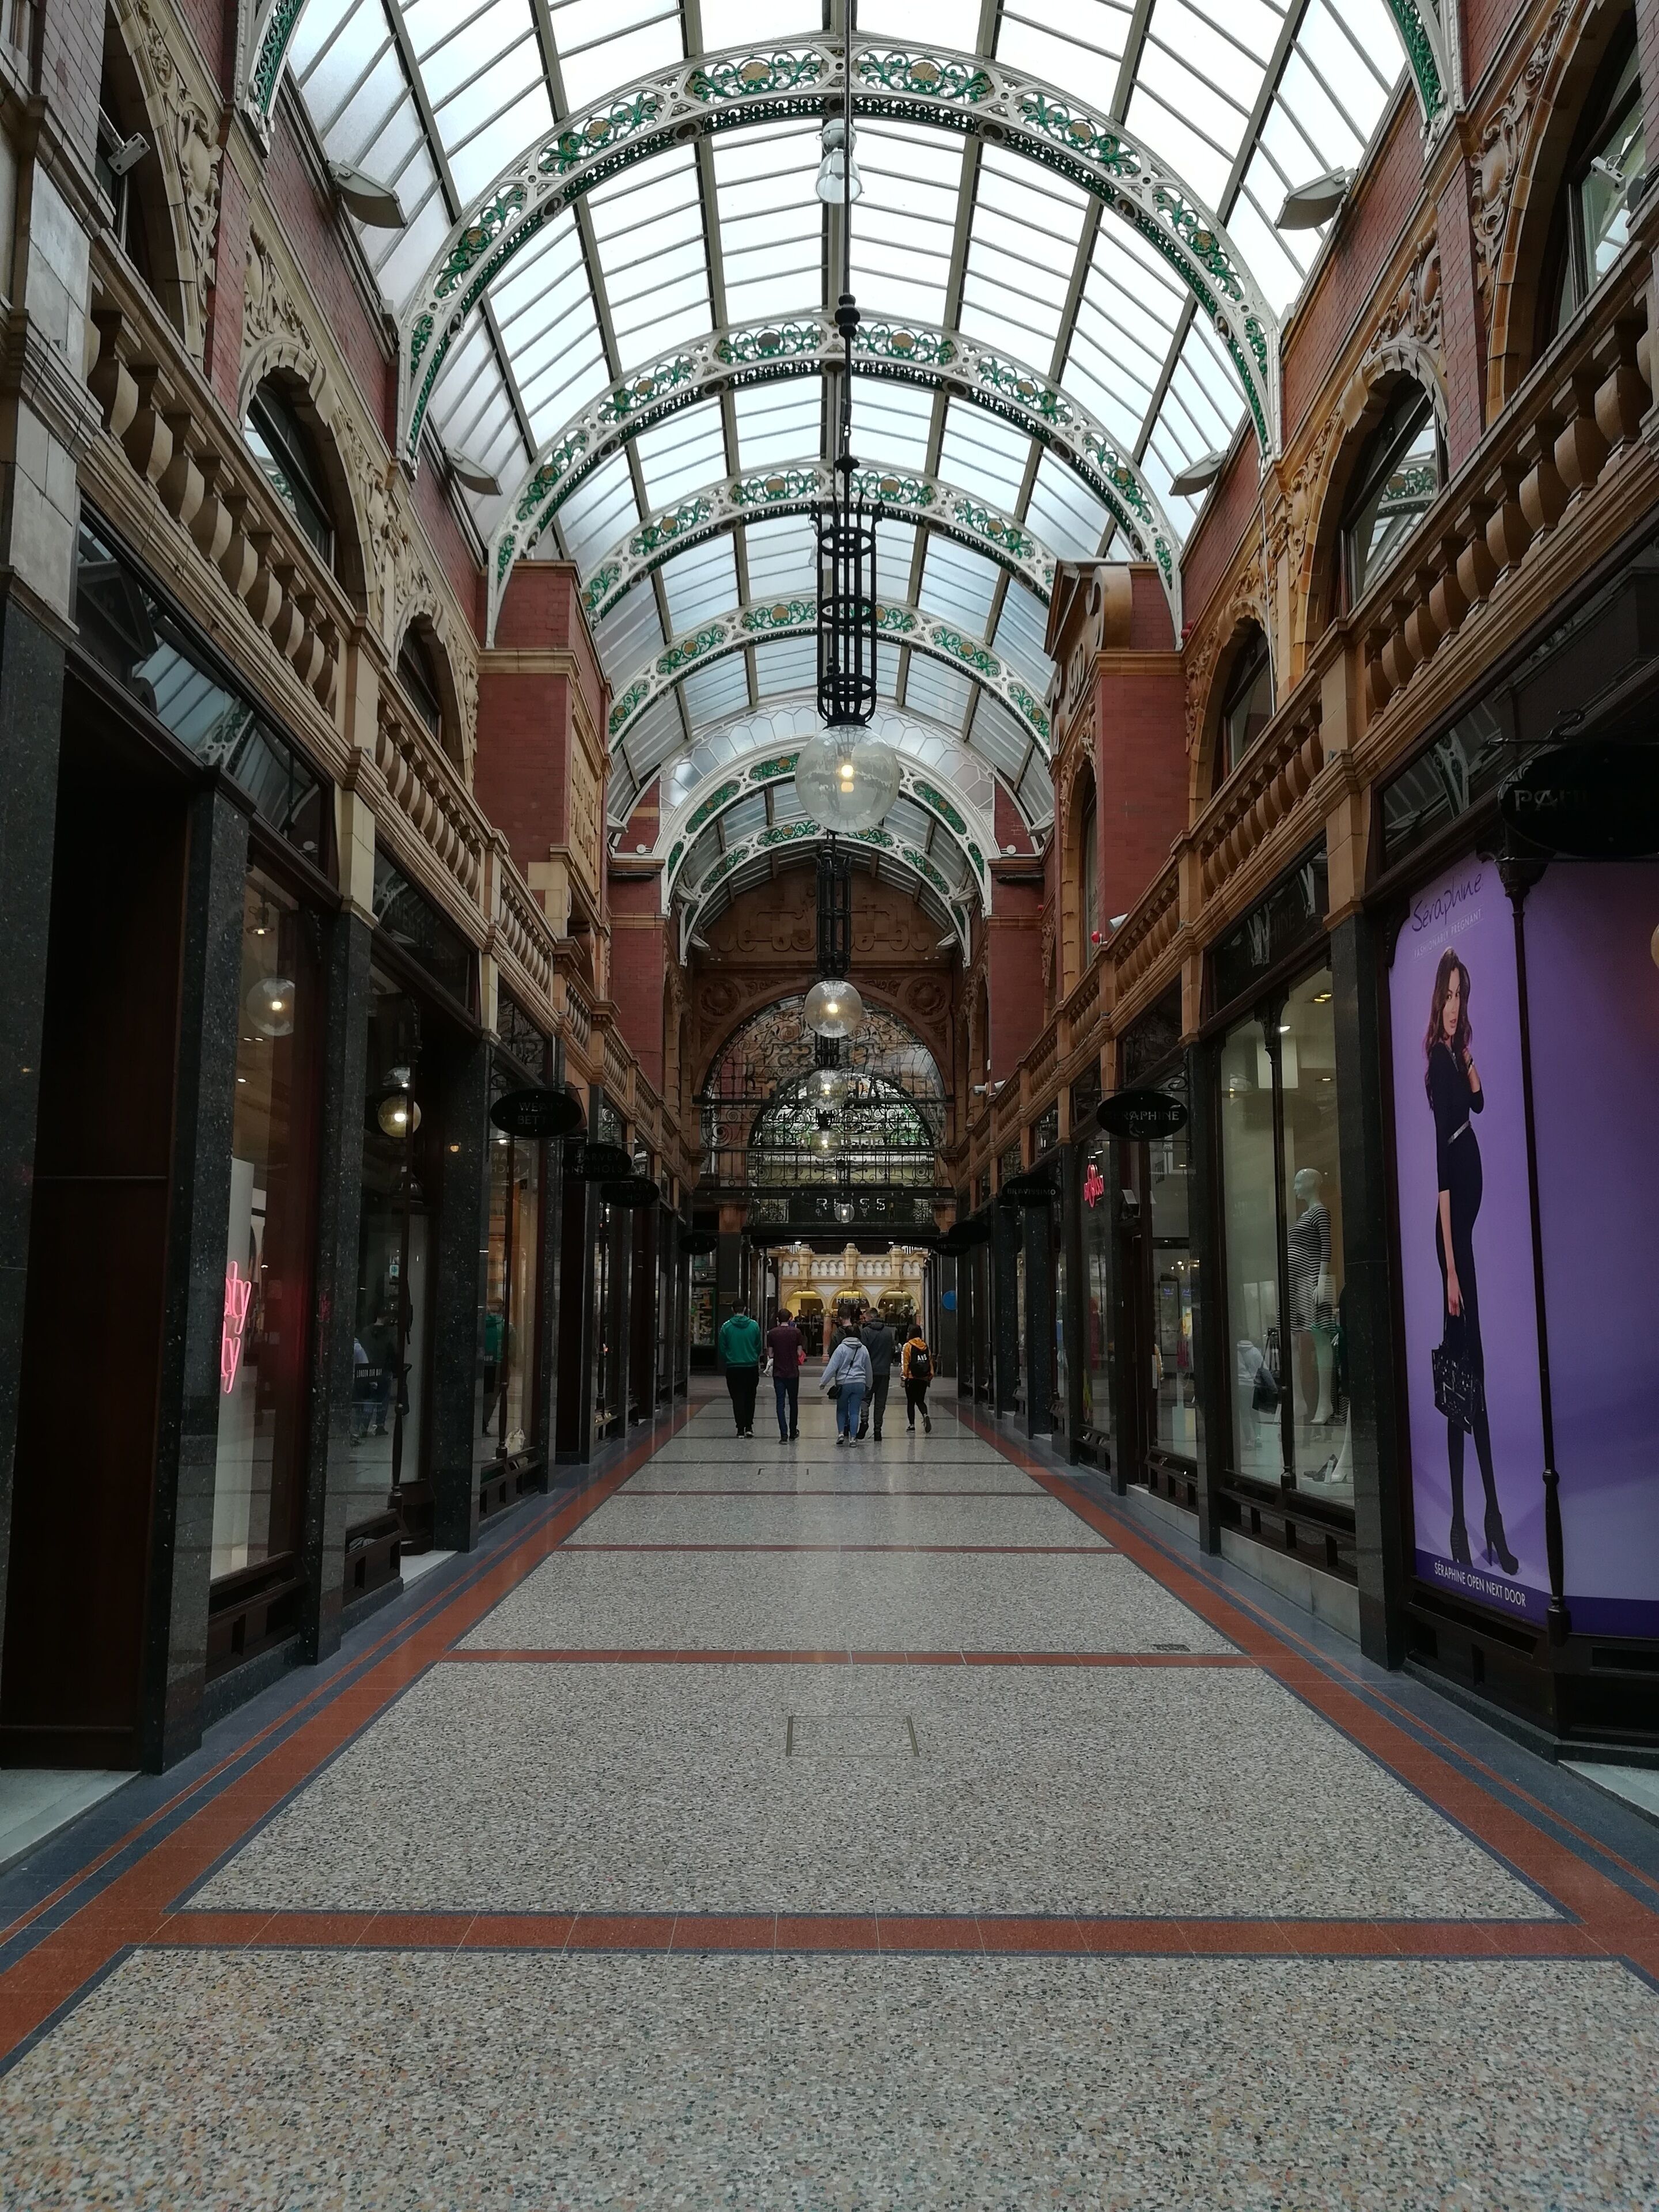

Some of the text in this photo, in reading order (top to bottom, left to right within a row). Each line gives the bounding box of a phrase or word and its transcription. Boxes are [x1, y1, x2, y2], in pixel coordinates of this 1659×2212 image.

[1414, 908, 1482, 958] FASHIONABLY PREGNANT
[517, 1115, 556, 1125] BETTY
[1104, 1110, 1180, 1121] SERAPHINE
[574, 1152, 621, 1162] HARVEY
[571, 1164, 623, 1174] NICHOLS
[613, 1183, 650, 1191] ARVEY
[1006, 1187, 1056, 1196] BRAVISSIMO
[356, 1369, 369, 1378] LONDON
[1434, 1560, 1527, 1607] SÉRAPHINE OPEN NEXT DOOR
